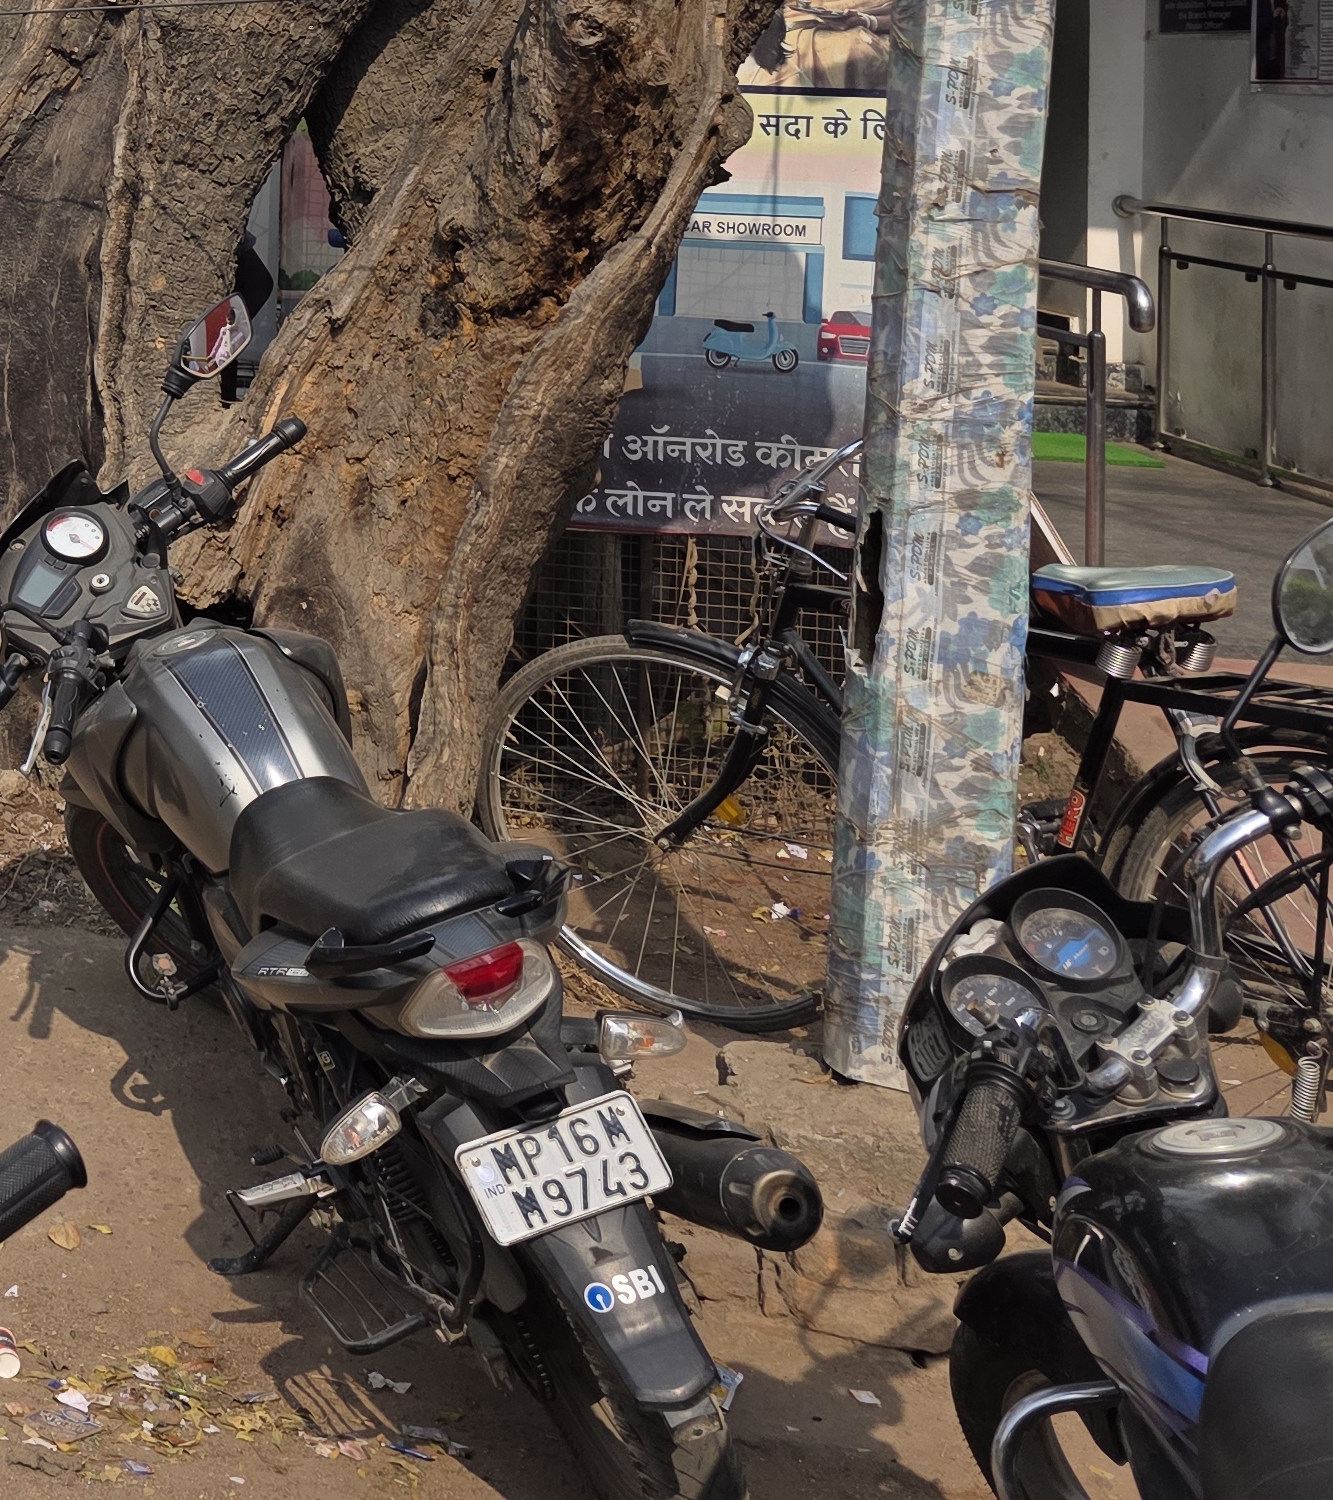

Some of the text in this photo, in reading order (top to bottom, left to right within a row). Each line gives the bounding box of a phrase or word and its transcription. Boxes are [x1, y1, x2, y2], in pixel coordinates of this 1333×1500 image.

[757, 113, 814, 140] सदा
[821, 108, 852, 139] के
[716, 221, 807, 237] SHOWROOM
[923, 339, 938, 390] S-PDM
[622, 424, 748, 468] ऑनरोड
[604, 480, 676, 519] लोन
[682, 484, 715, 523] ले
[909, 531, 925, 581] S-PDM
[903, 626, 919, 677] S-PDM
[1057, 788, 1087, 849] HERO
[489, 1105, 633, 1186] MP16M
[482, 1182, 507, 1200] IND
[509, 1151, 651, 1230] M9743
[611, 1264, 666, 1306] SBI
